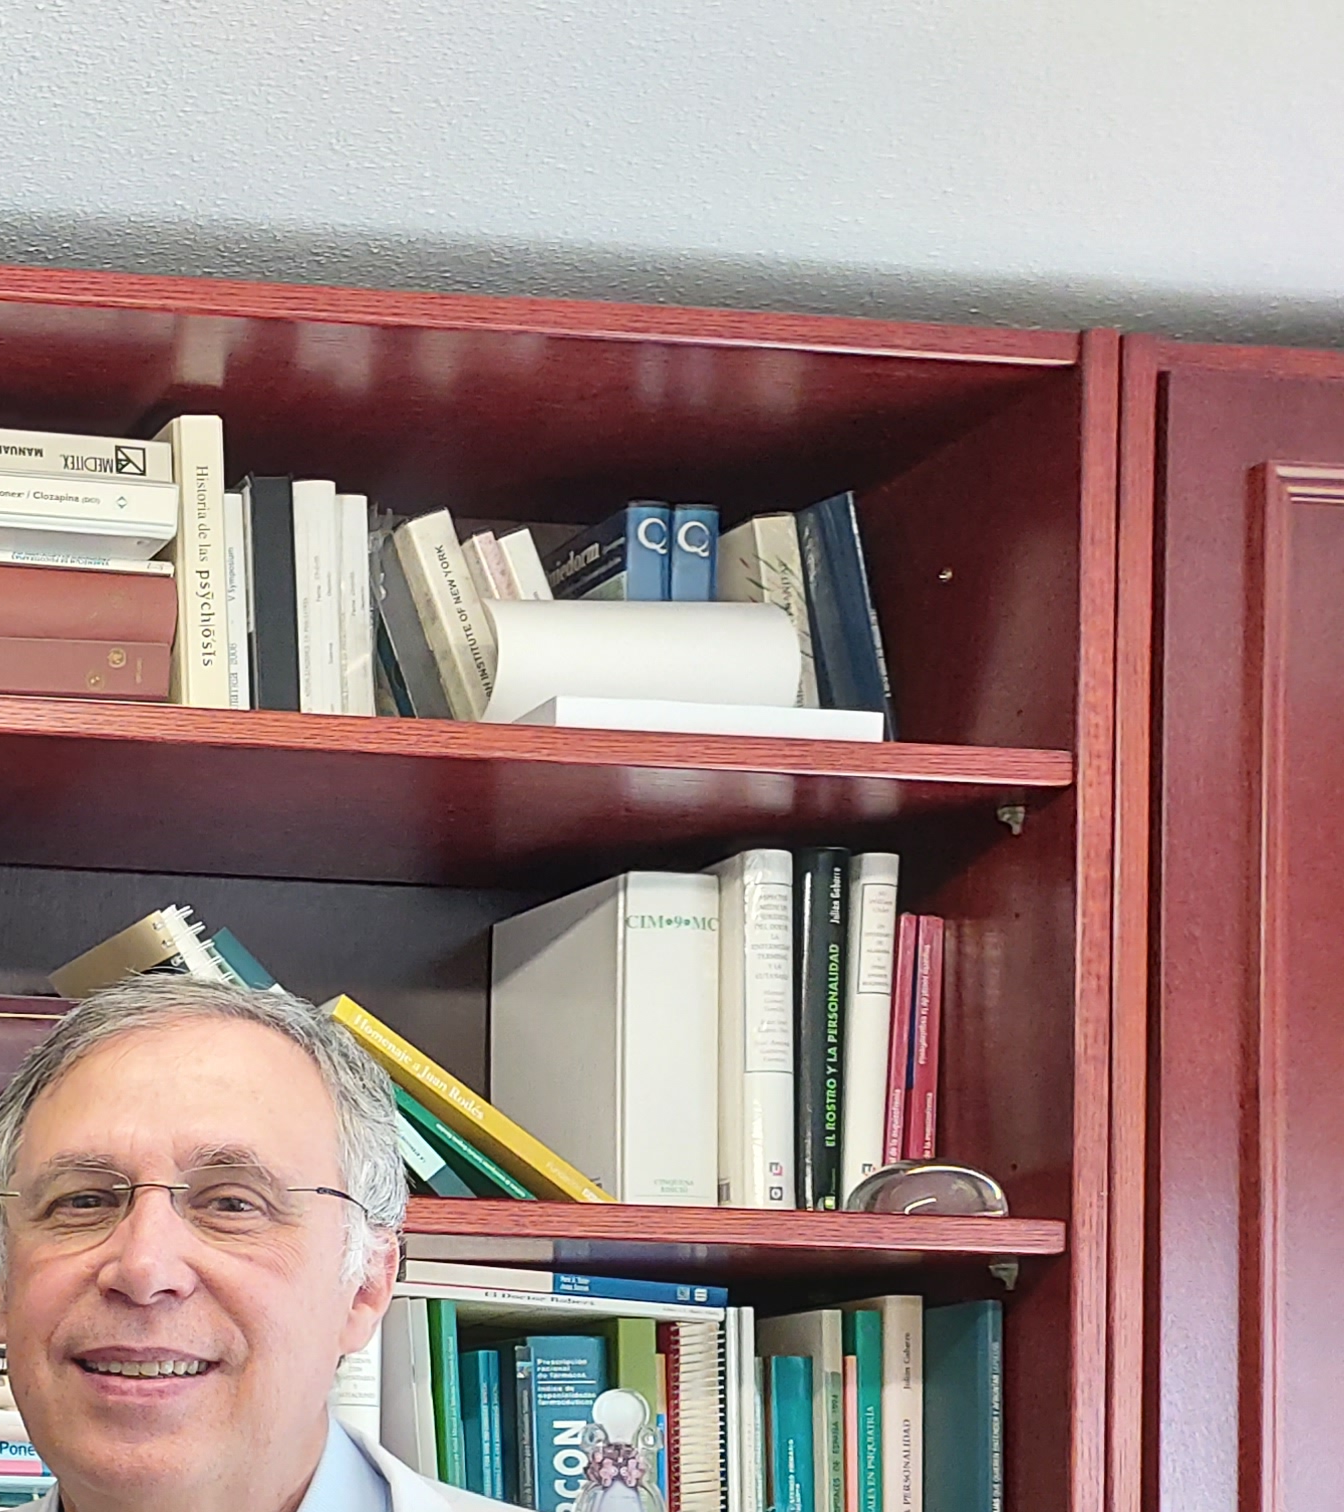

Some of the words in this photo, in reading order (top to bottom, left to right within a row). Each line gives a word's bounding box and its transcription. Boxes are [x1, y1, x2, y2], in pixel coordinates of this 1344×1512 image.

[32, 490, 81, 504] Clozapina
[195, 465, 210, 522] Historia
[197, 523, 210, 542] de
[637, 517, 669, 555] Q
[677, 520, 710, 558] Q
[198, 542, 210, 563] las
[434, 544, 452, 579] YORK
[445, 579, 462, 605] NEW
[456, 606, 470, 622] OF
[827, 943, 840, 1043] PERSONALIDAD
[826, 1044, 838, 1062] LA
[353, 1013, 413, 1064] Homenaje
[416, 1064, 448, 1093] Juan
[448, 1089, 485, 1121] Rodés
[826, 1064, 838, 1075] Y
[825, 1077, 837, 1130] ROSTRO
[825, 1131, 836, 1148] EL
[903, 1419, 912, 1506] PERSONALIDAD
[866, 1471, 876, 1486] EN
